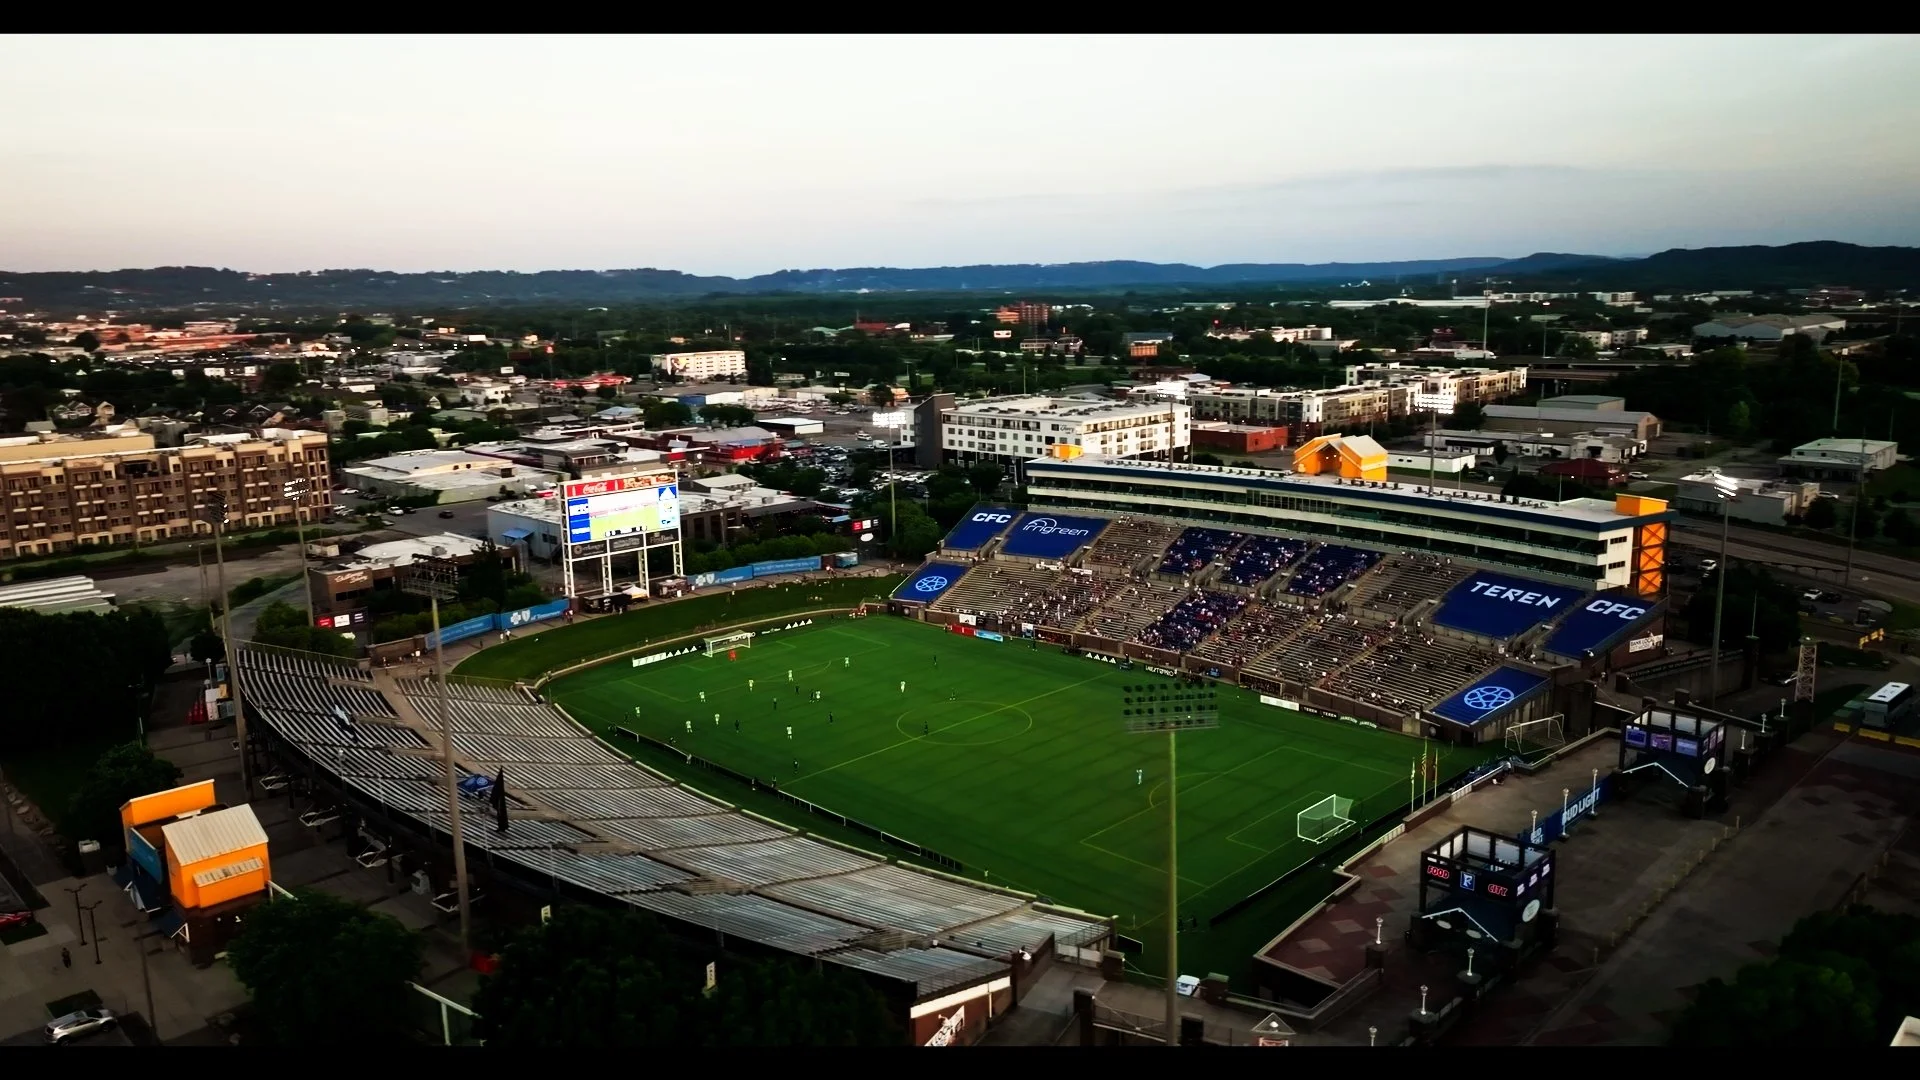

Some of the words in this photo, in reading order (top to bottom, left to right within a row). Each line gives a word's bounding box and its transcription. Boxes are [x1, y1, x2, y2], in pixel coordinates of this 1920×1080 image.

[971, 512, 1012, 524] CFC
[1022, 521, 1089, 536] irrigreen
[1470, 581, 1561, 609] TEREN
[1585, 599, 1646, 620] CFC
[1426, 865, 1450, 880] FOOD
[1487, 883, 1509, 897] CITY
